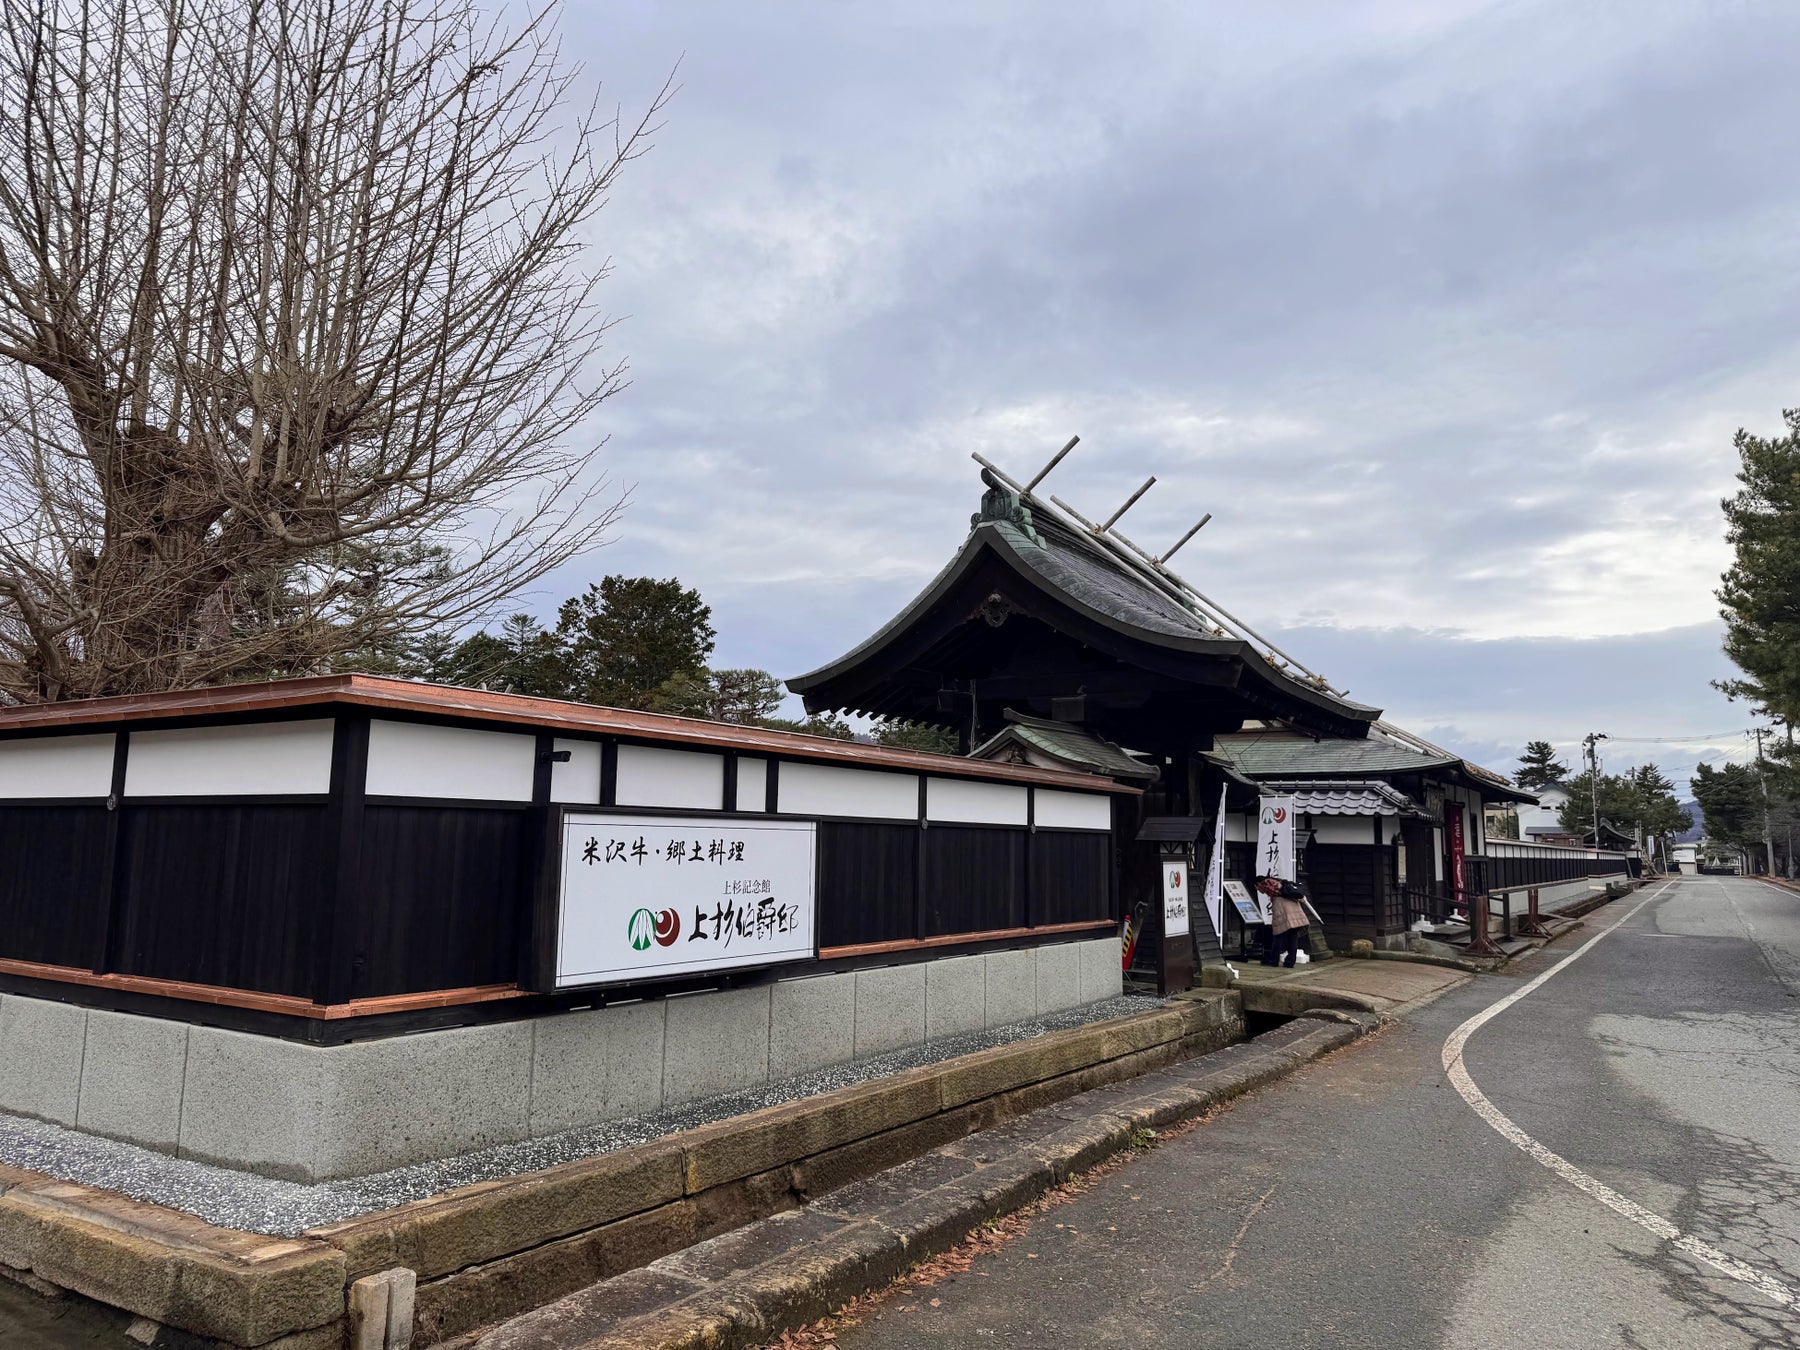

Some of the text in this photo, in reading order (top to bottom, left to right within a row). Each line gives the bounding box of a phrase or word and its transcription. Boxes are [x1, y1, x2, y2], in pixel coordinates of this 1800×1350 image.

[581, 836, 745, 866] 米沢牛・郷土料理
[722, 879, 771, 895] 上杉記念館
[688, 897, 799, 948] 上杉伯爵邸
